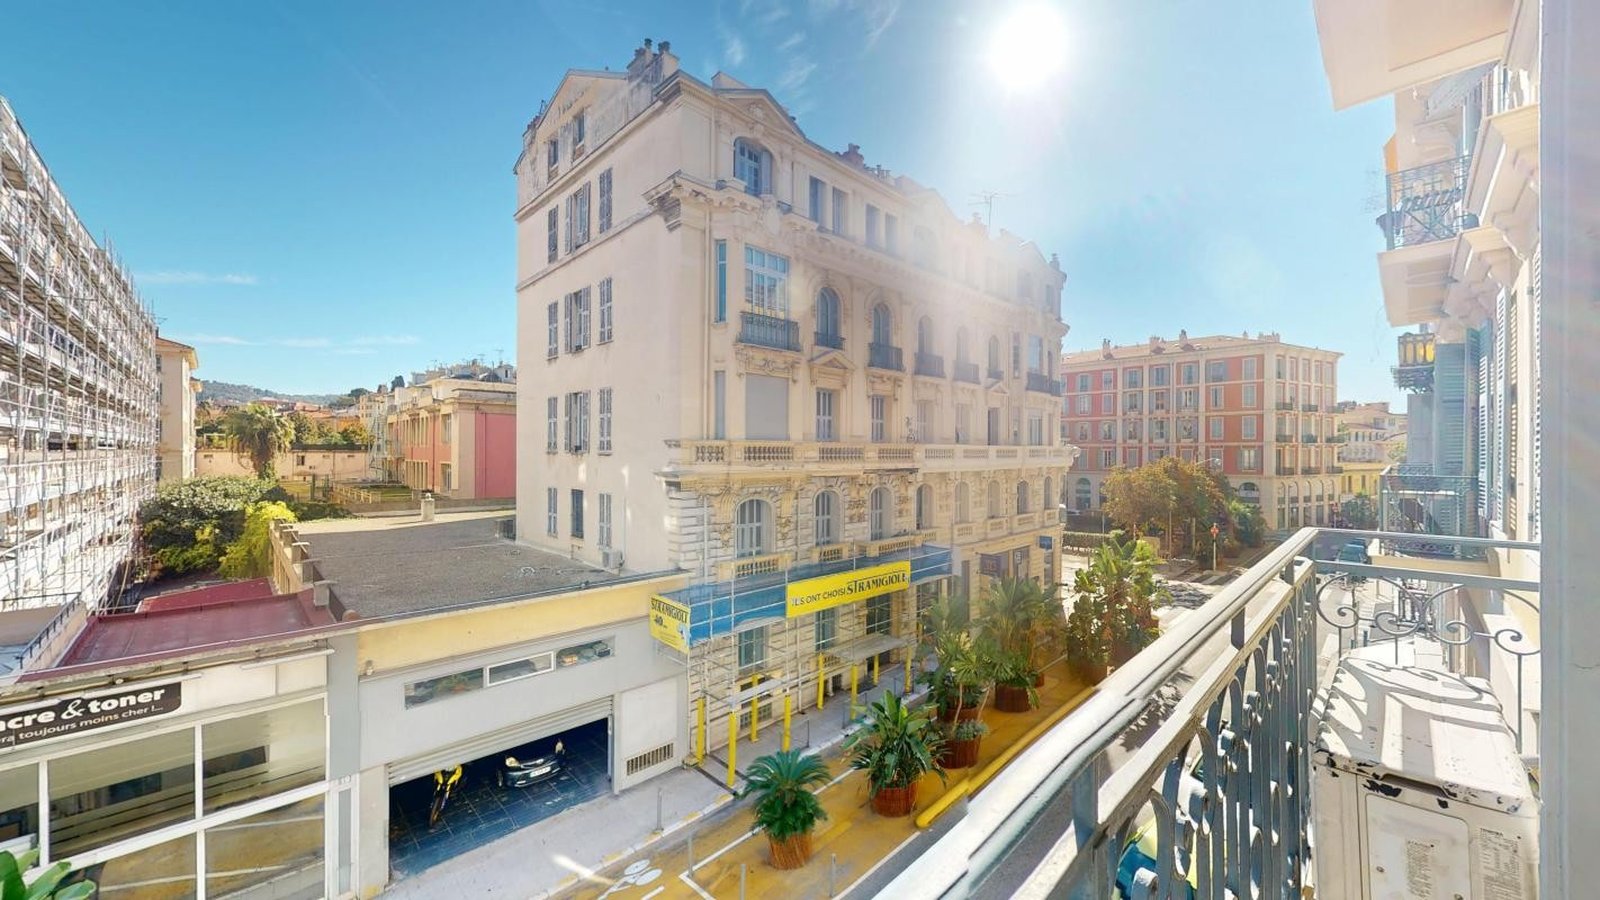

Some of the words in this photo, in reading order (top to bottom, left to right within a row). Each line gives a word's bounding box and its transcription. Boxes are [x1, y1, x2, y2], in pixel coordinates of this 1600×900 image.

[806, 593, 822, 604] ONT
[823, 587, 846, 599] CHOISI
[60, 699, 87, 720] &
[88, 688, 165, 713] toner
[18, 722, 77, 740] toujours
[79, 713, 120, 727] moins
[121, 706, 149, 718] cher
